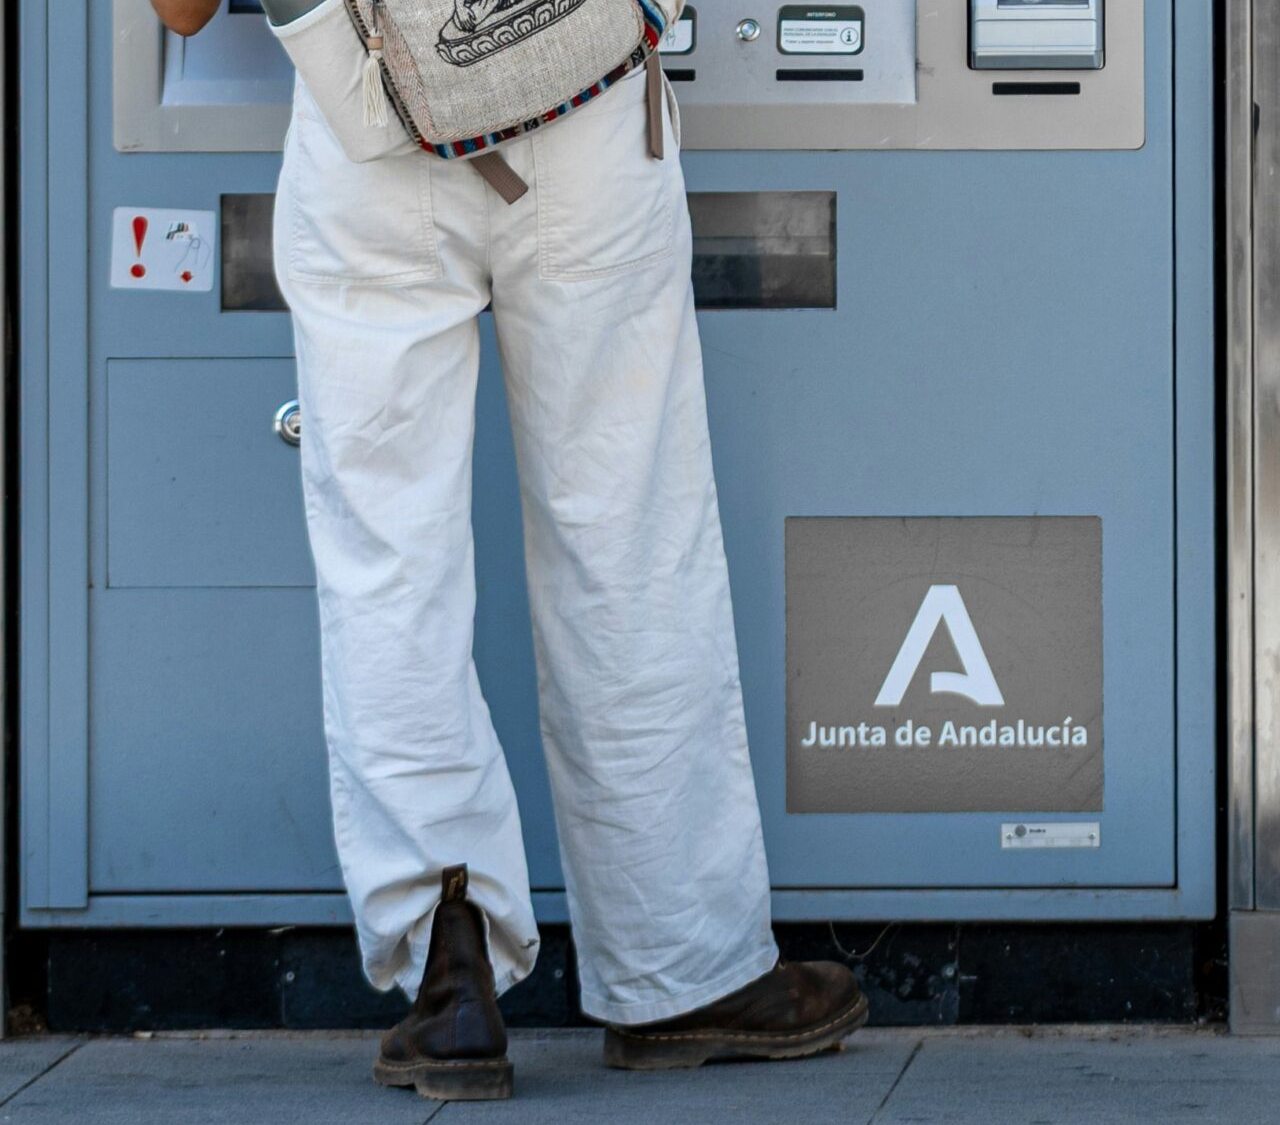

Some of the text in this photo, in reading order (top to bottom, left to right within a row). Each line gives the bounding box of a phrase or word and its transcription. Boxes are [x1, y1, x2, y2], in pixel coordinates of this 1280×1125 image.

[801, 715, 1088, 747] Junta de Andalucía
